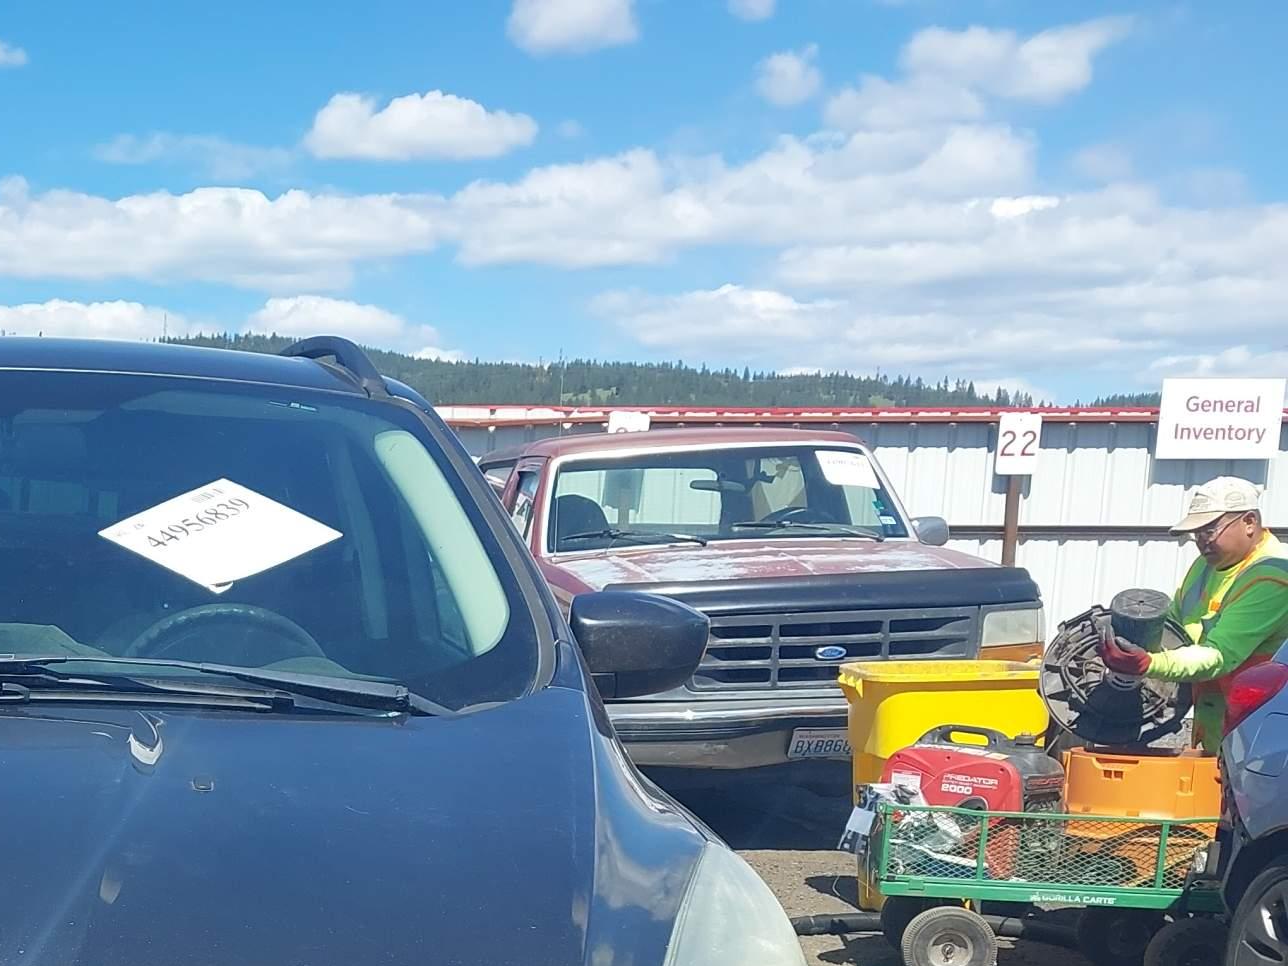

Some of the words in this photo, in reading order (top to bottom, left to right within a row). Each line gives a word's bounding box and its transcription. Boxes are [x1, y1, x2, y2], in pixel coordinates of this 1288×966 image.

[1185, 395, 1261, 413] General
[1000, 430, 1037, 456] 22
[1173, 423, 1267, 444] Inventory
[146, 497, 250, 548] 44956839
[942, 773, 999, 786] PREDATOR
[941, 783, 973, 796] 2000
